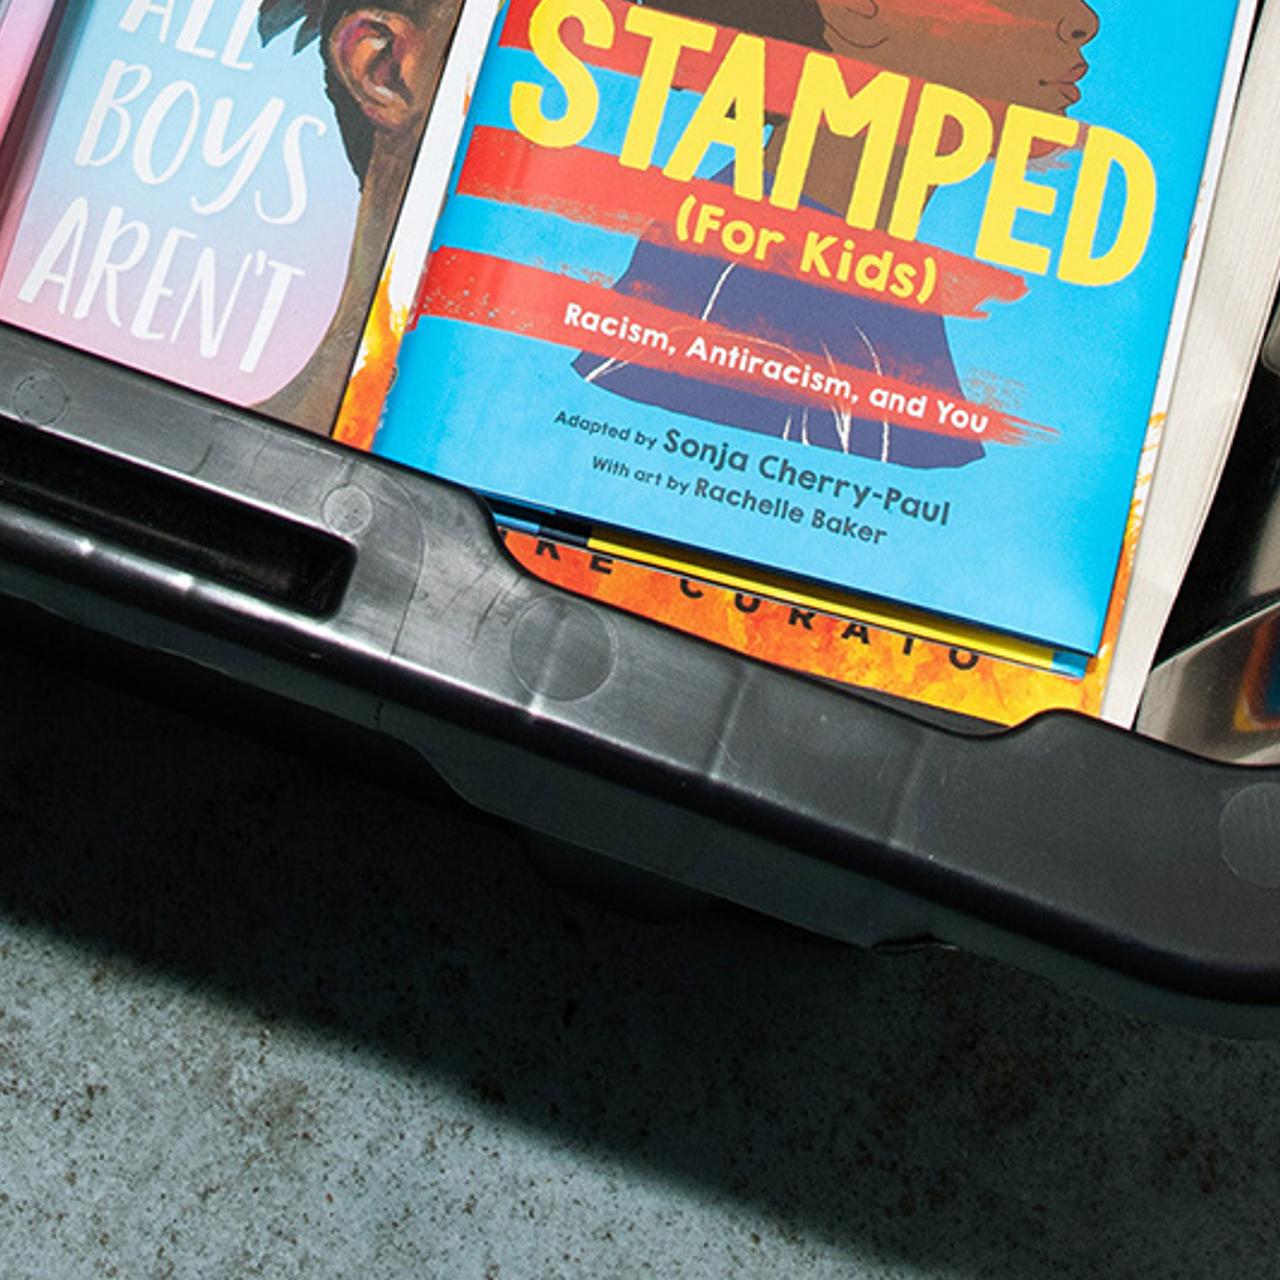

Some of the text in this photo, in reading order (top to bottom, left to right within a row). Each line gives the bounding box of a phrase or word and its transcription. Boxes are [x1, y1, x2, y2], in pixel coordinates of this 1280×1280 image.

[74, 59, 327, 225] BOYS
[17, 196, 306, 374] AREN'T
[675, 194, 939, 305] (For Kids)
[564, 302, 990, 434] Racism, Antiracism, and You
[554, 409, 951, 527] Adapted by Sonja Cherry-Paul
[591, 455, 888, 546] With art by Rachelle Baker
